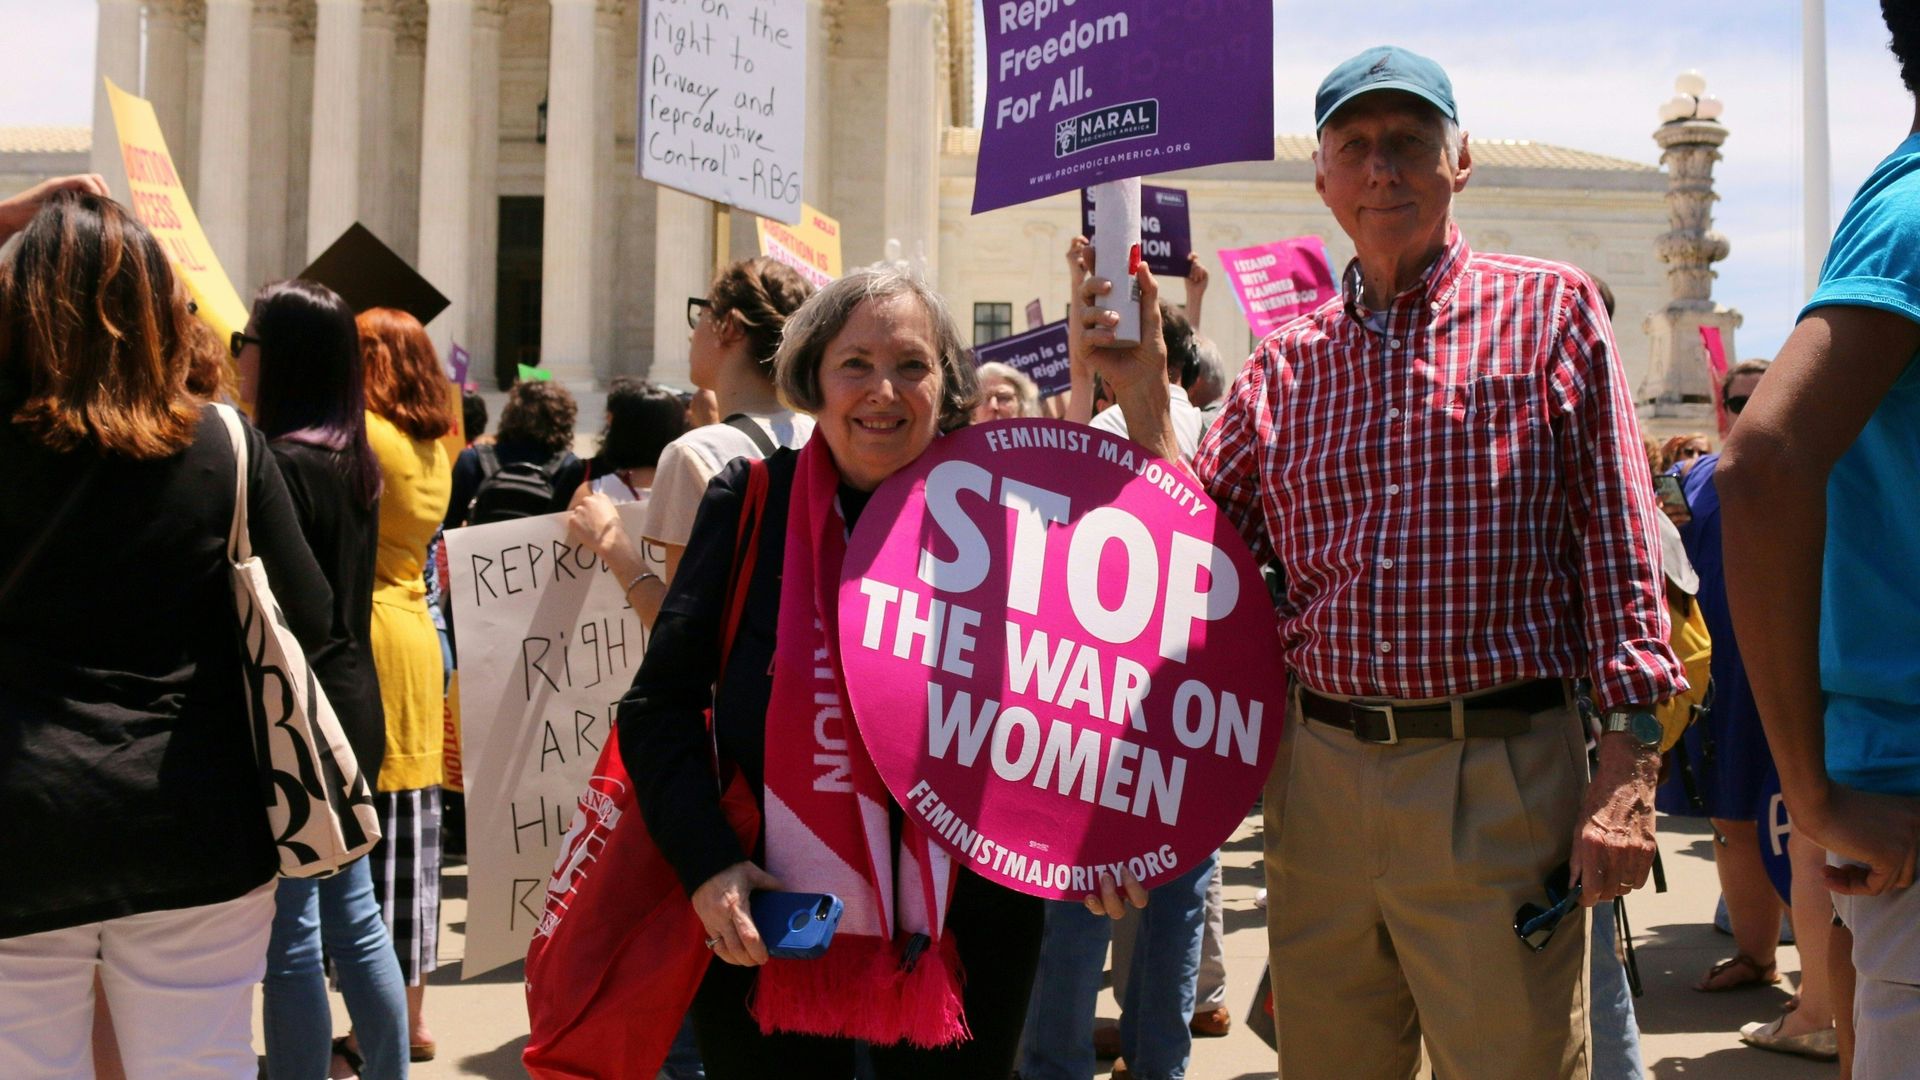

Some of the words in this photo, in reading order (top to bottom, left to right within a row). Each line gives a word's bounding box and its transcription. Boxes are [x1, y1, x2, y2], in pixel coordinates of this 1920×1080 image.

[654, 12, 716, 56] right
[730, 35, 754, 73] to
[749, 7, 792, 49] the
[999, 12, 1128, 82] Freedom
[650, 94, 775, 152] reproductive
[734, 86, 776, 116] and
[996, 91, 1042, 130] For
[1049, 66, 1093, 112] All.
[1080, 107, 1150, 137] NARAL
[1119, 124, 1150, 135] AMERICA
[1029, 142, 1192, 185] WWW.PROCHOICEAMERICA.ORG
[1056, 342, 1067, 353] a
[984, 426, 1091, 453] FEMINIST
[1097, 439, 1208, 518] MAJORITY
[918, 460, 1240, 664] STOP
[859, 577, 982, 679] THE
[1005, 620, 1152, 732] WAR
[1172, 680, 1265, 767] ON
[927, 681, 1188, 827] WOMEN
